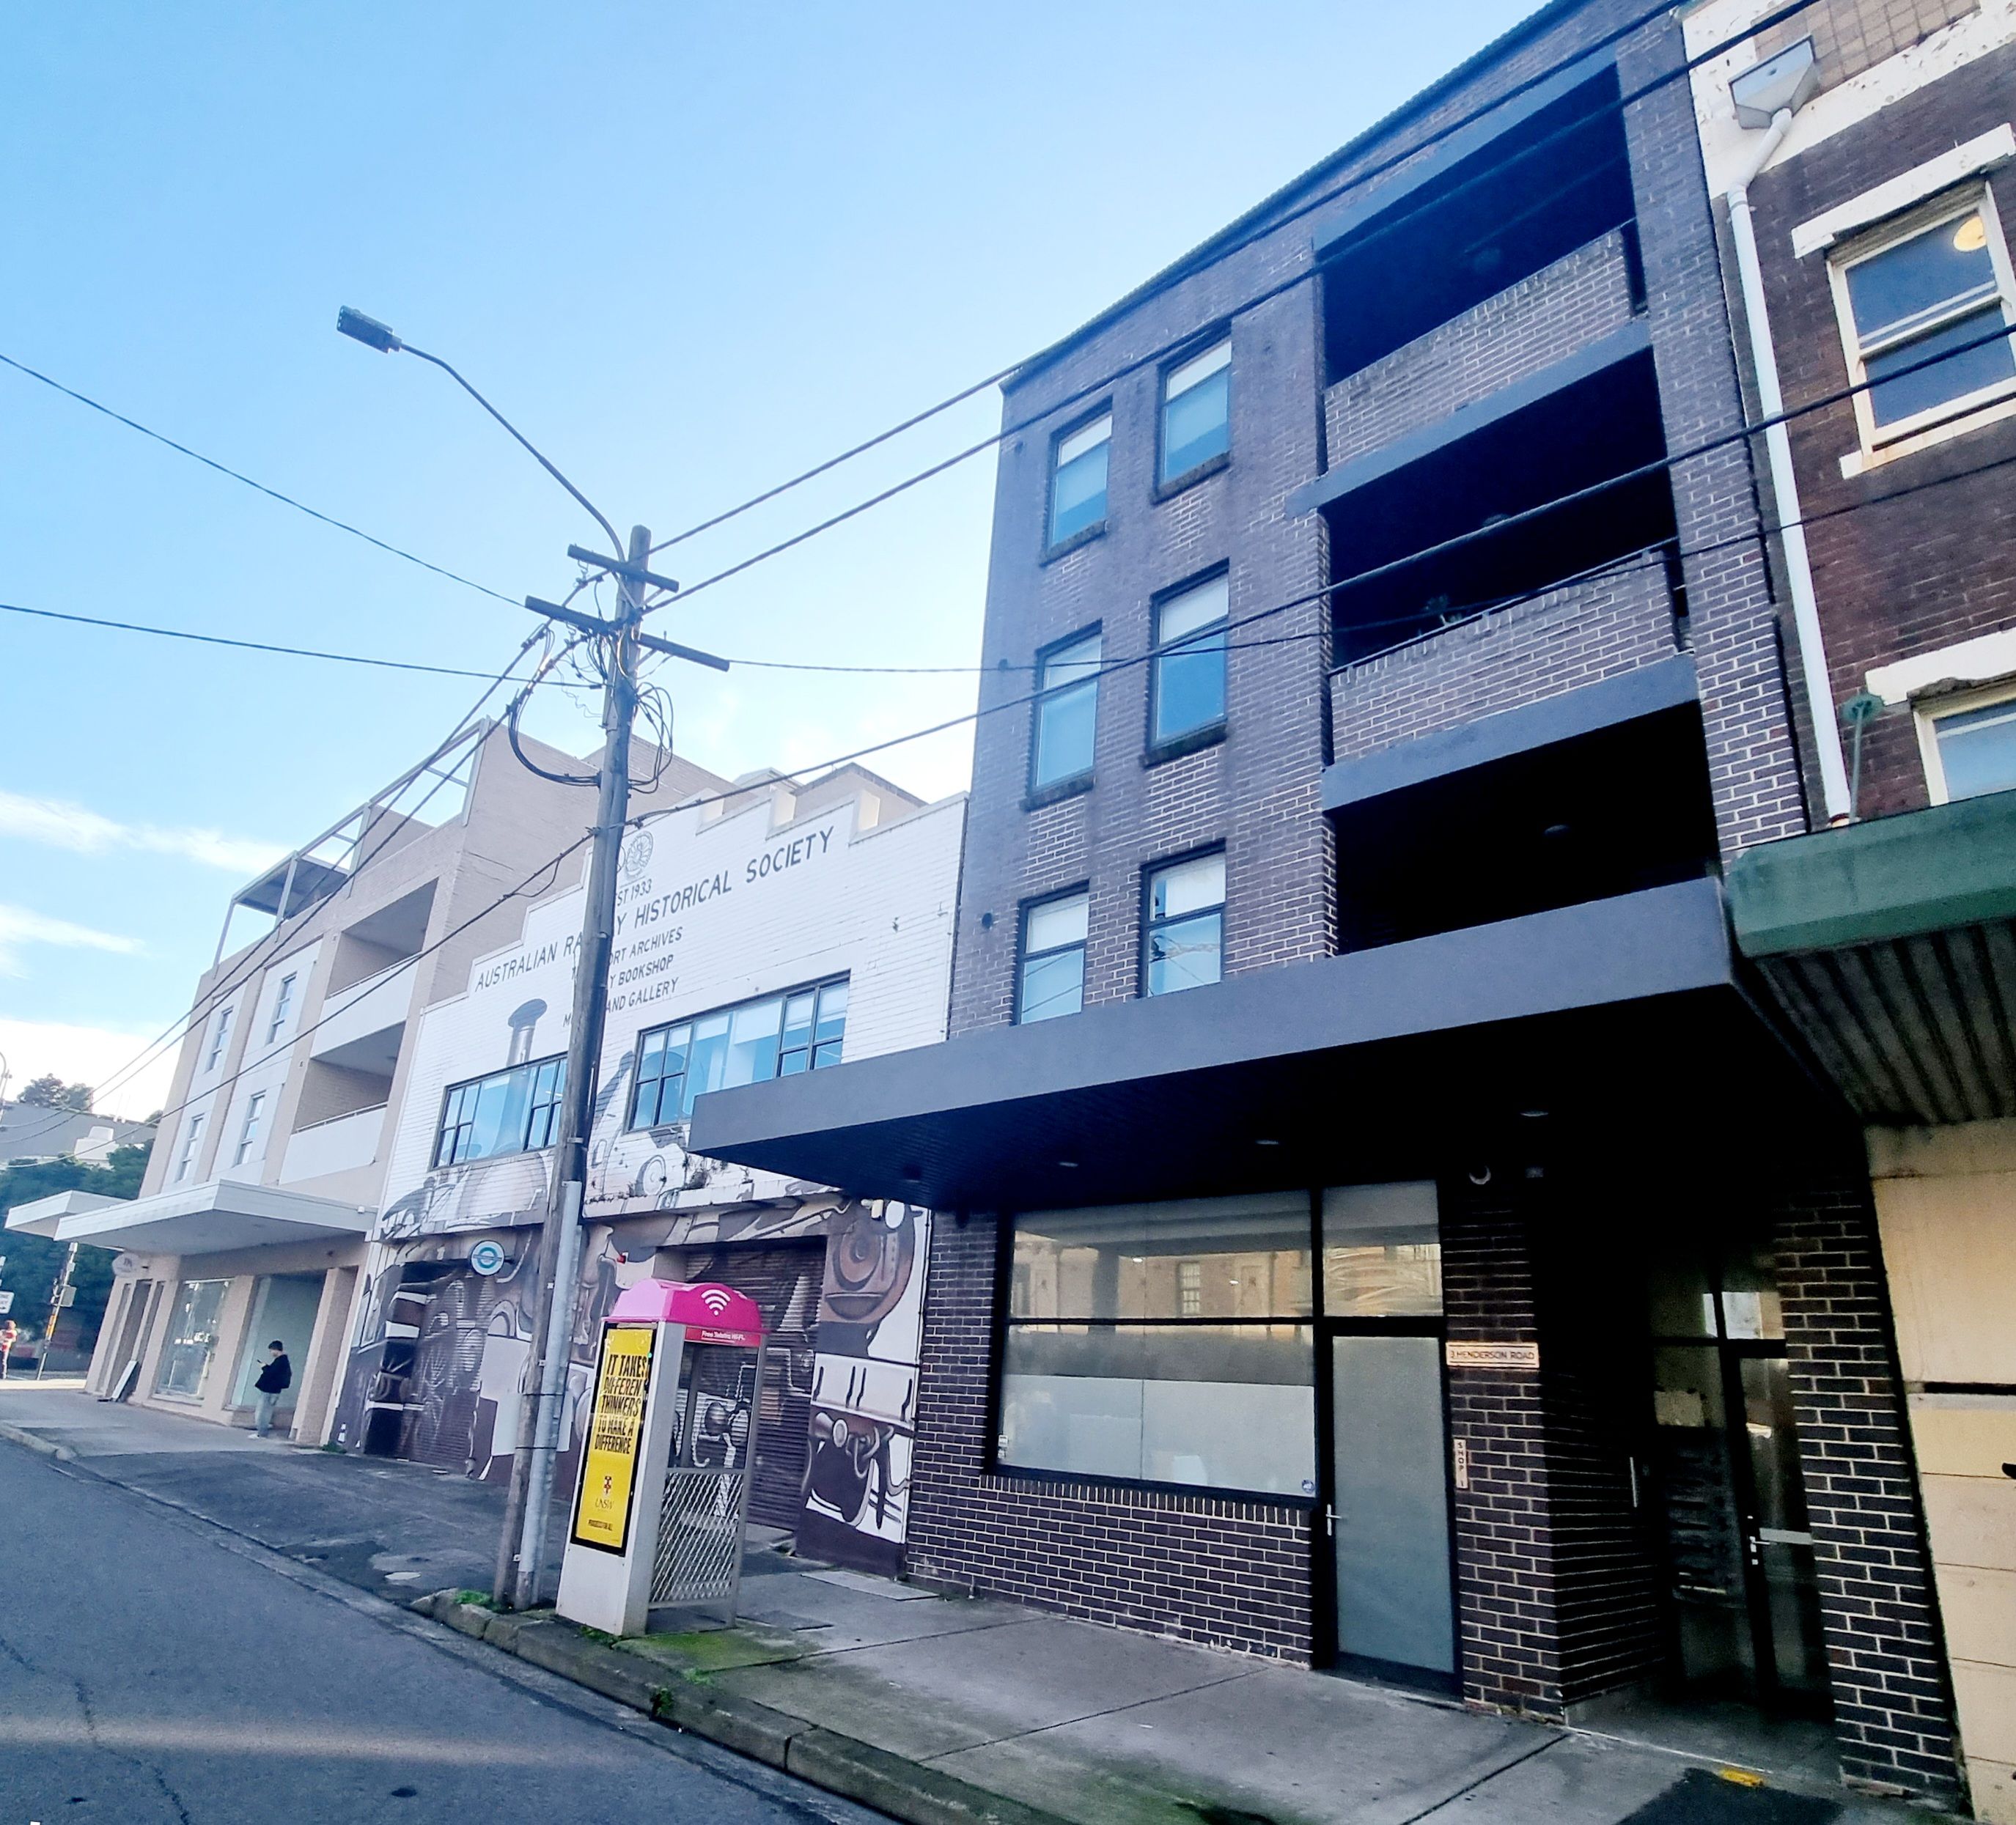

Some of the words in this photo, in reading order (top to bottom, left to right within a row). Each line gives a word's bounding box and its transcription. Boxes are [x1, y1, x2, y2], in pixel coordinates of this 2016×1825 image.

[630, 878, 652, 902] 1933
[475, 941, 558, 992] AUSTRALIAN
[635, 870, 732, 929] HISTORICAL
[746, 825, 834, 883] SOCIETY
[629, 926, 683, 958] ARCHIVES
[618, 954, 674, 986] BOOKSHOP
[628, 976, 679, 1007] GALLERY
[607, 1354, 619, 1376] IT
[618, 1354, 647, 1377] TAKES
[1457, 1351, 1507, 1359] HENDERSON
[1510, 1352, 1535, 1360] ROAD
[604, 1376, 643, 1397] DIFFEREN
[600, 1394, 641, 1417] THINKERS
[597, 1415, 608, 1432] TO
[608, 1417, 630, 1436] MAKE
[595, 1434, 632, 1455] DIFFERENCE
